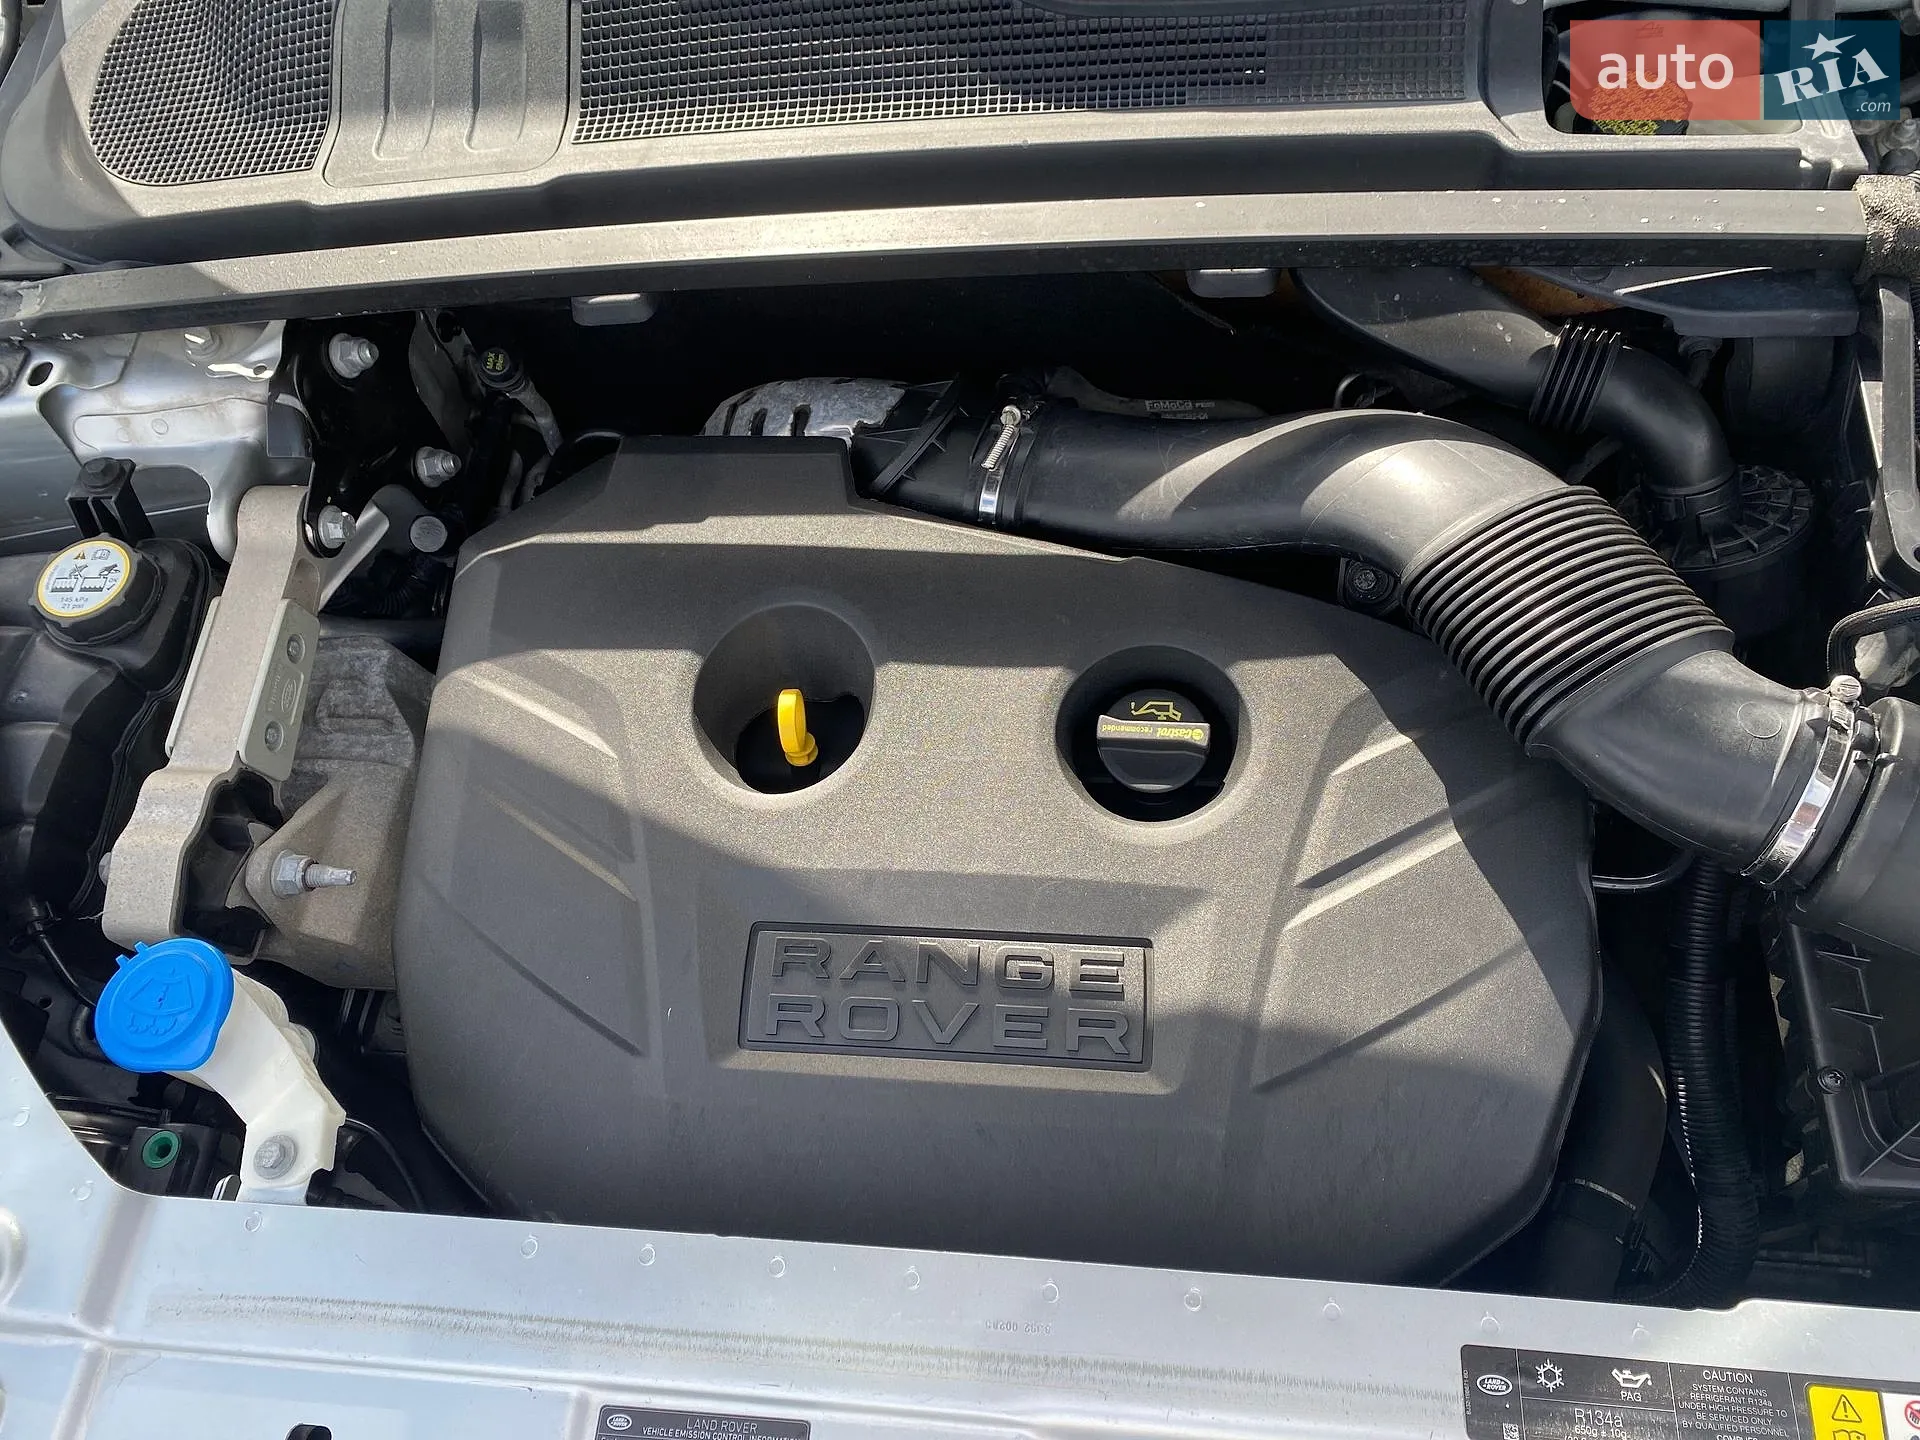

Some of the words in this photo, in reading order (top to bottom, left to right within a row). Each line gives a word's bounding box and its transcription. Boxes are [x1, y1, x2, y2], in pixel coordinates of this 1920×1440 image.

[1102, 724, 1152, 734] recommended
[1156, 727, 1192, 739] Castrol
[771, 937, 1125, 998] RANGE
[766, 993, 1130, 1055] ROVER
[1702, 1370, 1754, 1384] CAUTION
[1620, 1390, 1642, 1402] PAG
[1692, 1383, 1725, 1394] SYSTEM
[1726, 1386, 1768, 1397] CONTAINS
[1690, 1392, 1746, 1404] REFRIGERANT
[1748, 1399, 1772, 1407] R134a
[1678, 1401, 1707, 1411] UNDER
[1709, 1404, 1730, 1412] HIGH
[1731, 1405, 1774, 1417] PRESSURE
[1775, 1409, 1788, 1418] TO
[1574, 1407, 1624, 1428] R134a
[1696, 1411, 1707, 1420] BE
[1708, 1413, 1749, 1424] SERVICED
[1750, 1417, 1772, 1426] ONLY
[686, 1418, 718, 1431] LAND
[720, 1421, 758, 1434] ROVER
[1574, 1424, 1598, 1438] 650g
[1682, 1420, 1693, 1428] BY
[1695, 1421, 1738, 1433] QUALIFIED
[642, 1427, 674, 1437] VEHICLE
[675, 1429, 711, 1440] EMISSION
